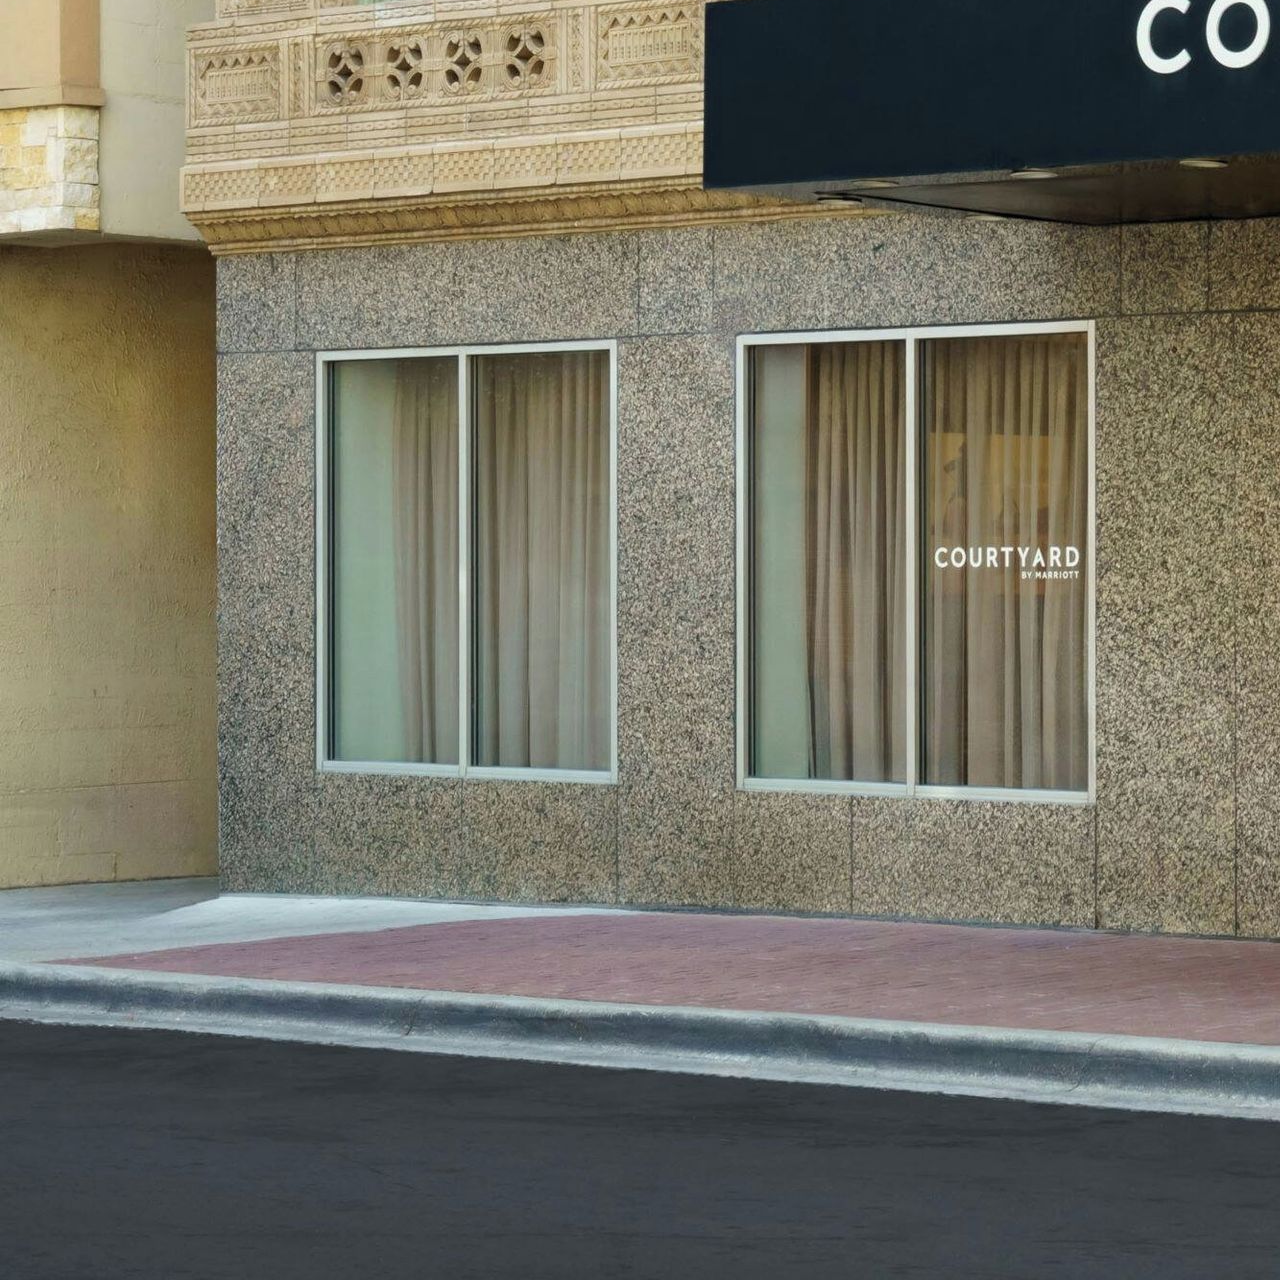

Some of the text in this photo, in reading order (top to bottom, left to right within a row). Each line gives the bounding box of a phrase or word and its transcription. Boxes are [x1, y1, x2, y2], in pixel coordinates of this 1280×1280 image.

[934, 546, 1080, 568] COURTYARD
[1021, 570, 1080, 580] BY MARRIOTT
